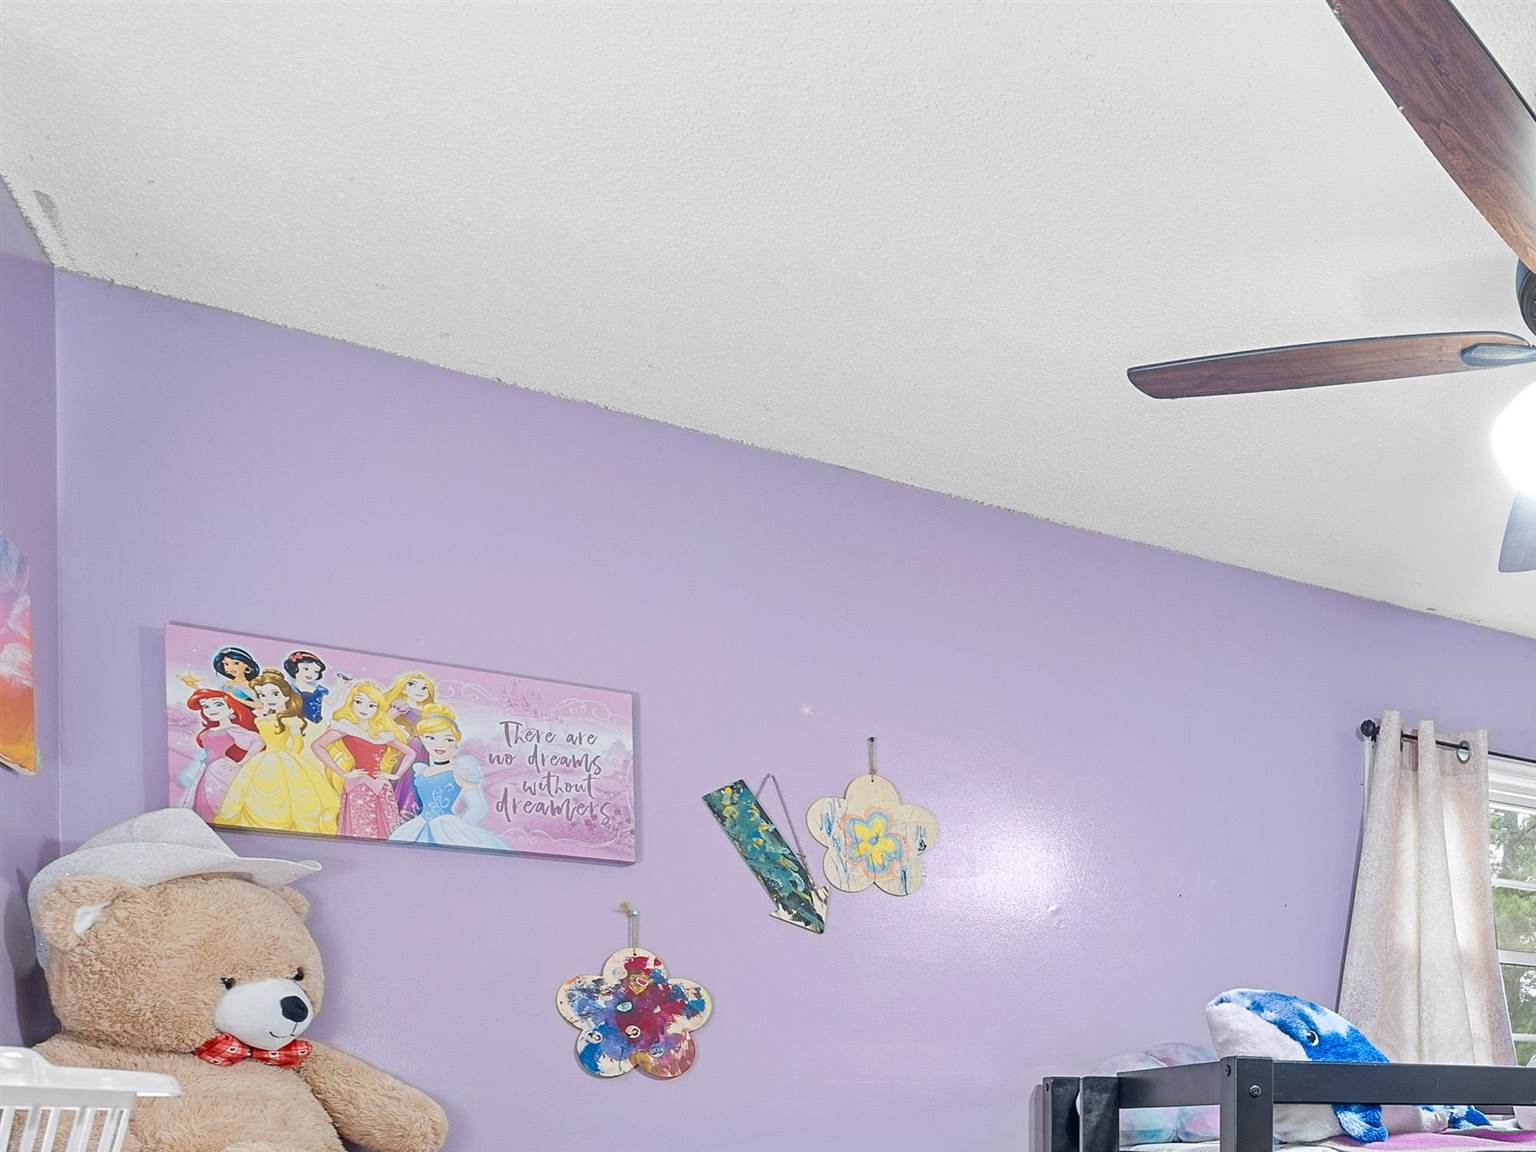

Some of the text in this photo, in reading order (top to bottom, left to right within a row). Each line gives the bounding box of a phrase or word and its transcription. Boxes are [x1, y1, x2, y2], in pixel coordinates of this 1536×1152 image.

[499, 721, 598, 748] There are
[488, 744, 601, 775] no dreams
[522, 771, 600, 799] without
[496, 787, 612, 825] dreamers
